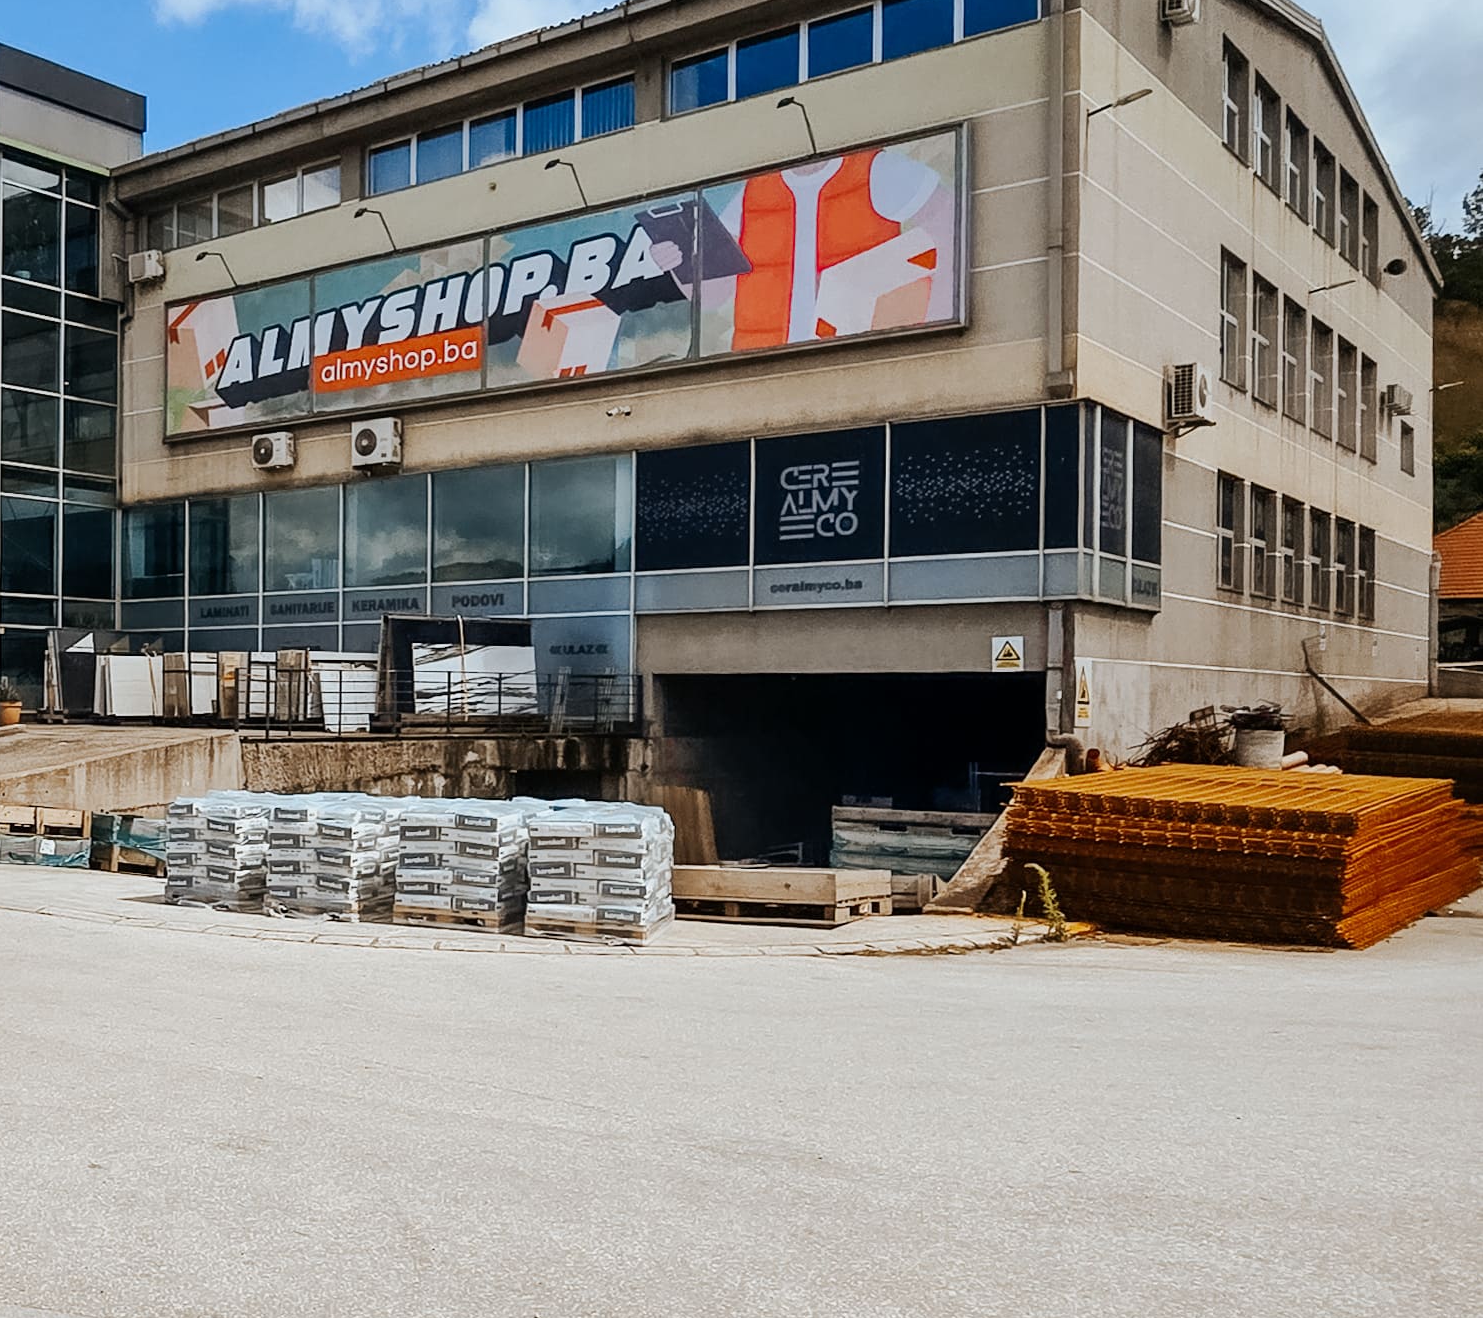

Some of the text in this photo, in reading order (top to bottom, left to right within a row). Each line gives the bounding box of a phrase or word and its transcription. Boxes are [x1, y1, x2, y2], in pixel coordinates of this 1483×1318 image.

[218, 224, 666, 388] ALMYSHOP.BA
[320, 339, 479, 382] almyshop.ba
[780, 486, 858, 516] ALMY
[352, 597, 420, 612] KERAMIKA
[452, 593, 505, 608] PODOVI
[200, 604, 250, 619] LAMINATI
[269, 601, 335, 616] SANITARIJE
